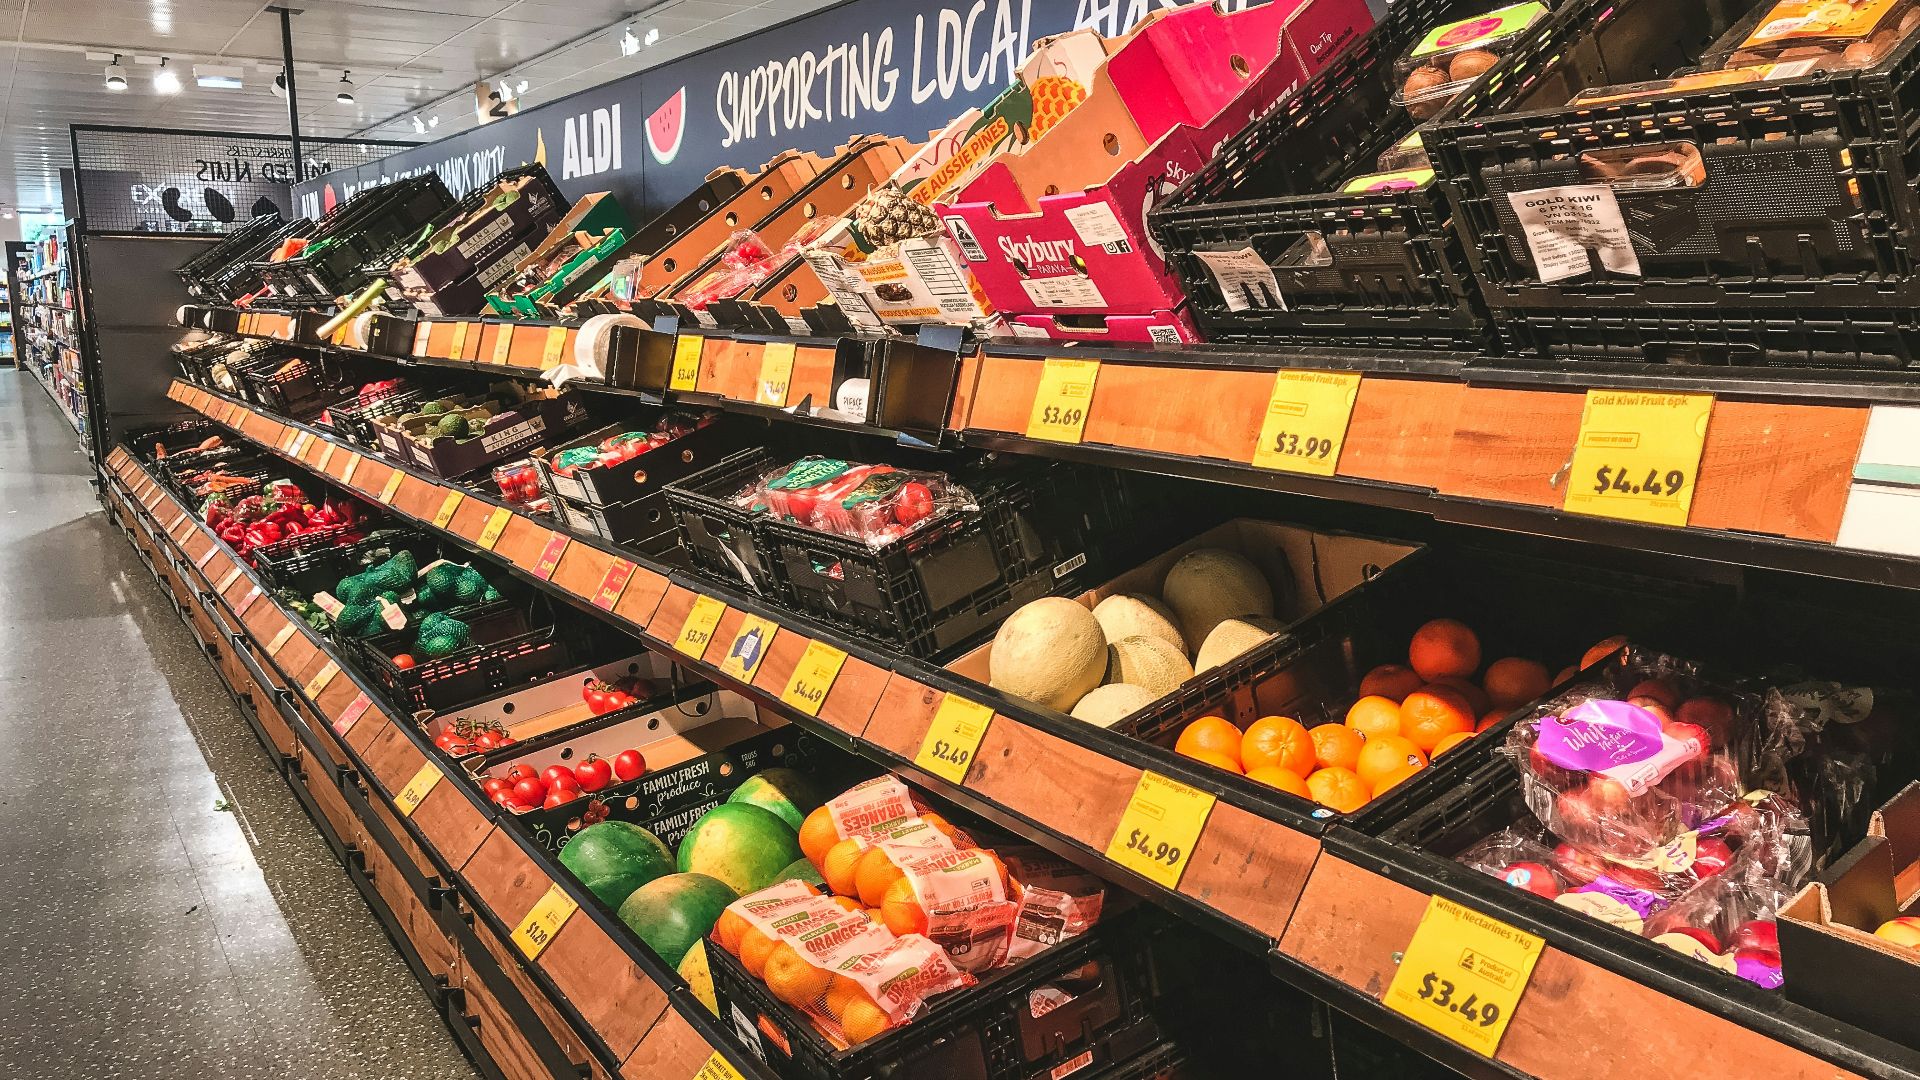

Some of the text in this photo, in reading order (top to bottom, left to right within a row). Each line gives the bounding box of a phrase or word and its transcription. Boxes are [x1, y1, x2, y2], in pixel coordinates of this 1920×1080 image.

[1310, 31, 1333, 54] Our Tip
[717, 26, 900, 148] SUPPORTING
[489, 91, 508, 117] 2
[562, 104, 623, 180] ALDI
[473, 145, 506, 189] DIRTY
[929, 150, 973, 193] AUSSIE
[970, 118, 1007, 157] PINES
[1525, 194, 1601, 208] GOLD KIWI
[1549, 204, 1568, 212] PK
[465, 228, 489, 247] KING
[997, 233, 1075, 269] Skybury
[485, 258, 508, 276] KING
[1036, 263, 1069, 275] PAPAYA
[1568, 261, 1591, 271] PRODUC
[678, 368, 696, 381] $3.49
[1280, 373, 1300, 382] Green
[1301, 374, 1317, 382] Kiwi
[1317, 375, 1333, 385] Fruit
[1592, 395, 1689, 408] Gold Kiwi Fruit 6pk
[1043, 404, 1082, 426] $3.69
[491, 426, 519, 442] KING
[491, 433, 525, 450] AVOCADO
[1274, 430, 1332, 459] $3.99
[1594, 464, 1685, 497] $4.49
[685, 628, 708, 645] $3.79
[793, 680, 824, 703] $4.49
[1562, 722, 1608, 752] White
[931, 739, 969, 766] $2.49
[643, 760, 710, 796] FAMILY FRESH
[1162, 778, 1188, 795] Oranges
[1187, 789, 1199, 798] Per
[656, 779, 702, 807] produce
[653, 809, 688, 836] FAMILY
[842, 803, 906, 833] ORANGES
[1126, 828, 1181, 866] $4.99
[525, 920, 548, 946] $1.29
[771, 914, 800, 929] MARKET
[801, 924, 828, 942] MARKET
[1436, 900, 1533, 950] White Nectarines 1kg
[804, 921, 869, 954] ORANGES
[1478, 966, 1507, 985] Australia
[1480, 958, 1504, 975] Product
[886, 958, 949, 1005] ORANGES
[1417, 971, 1500, 1028] $3.49
[711, 1057, 727, 1074] MARKET
